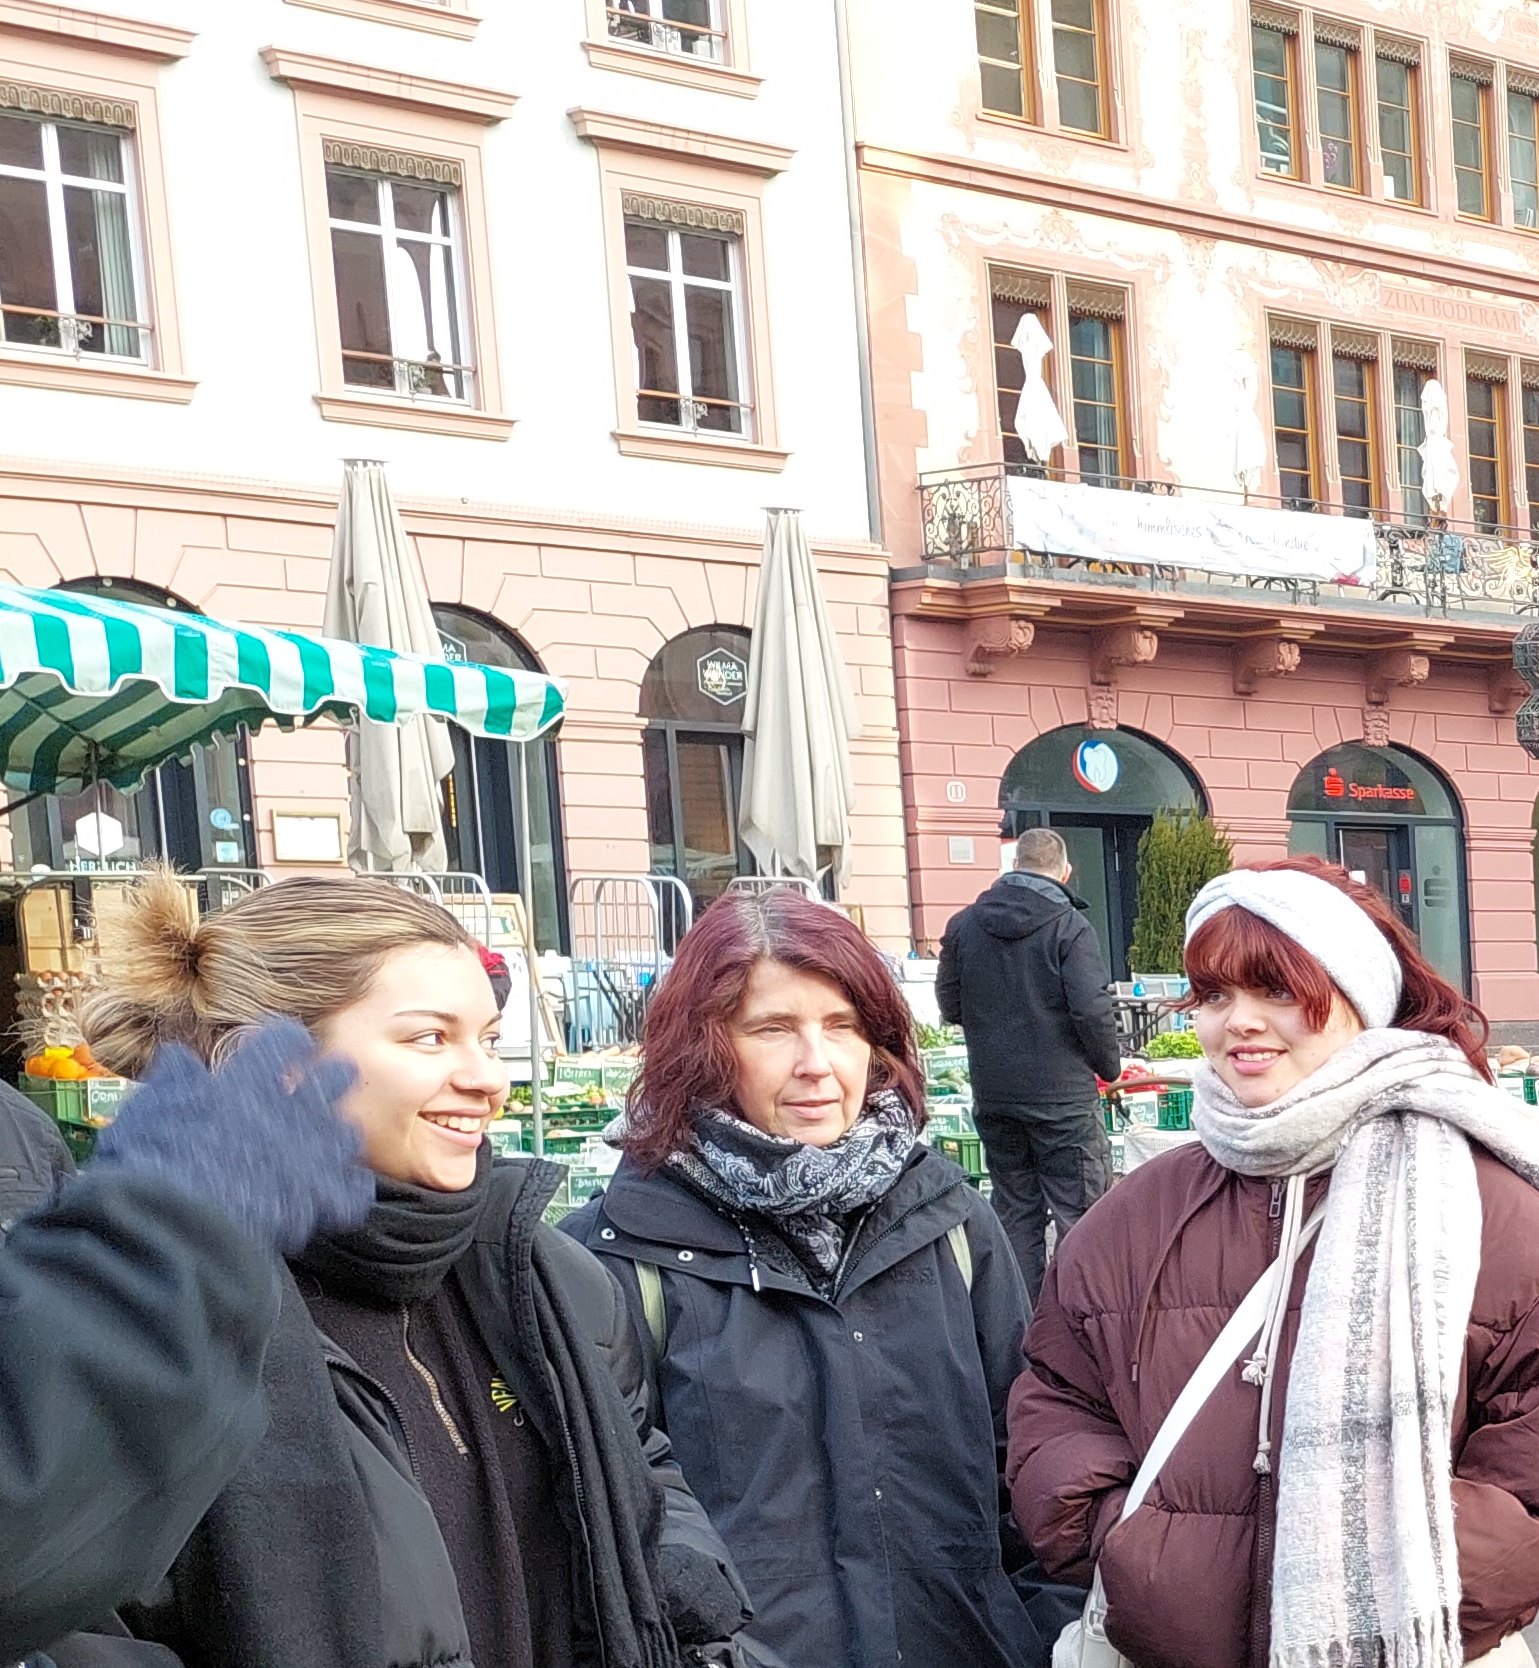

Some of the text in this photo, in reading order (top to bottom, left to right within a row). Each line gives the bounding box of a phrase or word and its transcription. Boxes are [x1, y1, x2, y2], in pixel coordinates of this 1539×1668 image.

[1384, 290, 1426, 314] ZUM
[1432, 298, 1518, 331] BODERAM
[1348, 782, 1416, 801] Sparkasse
